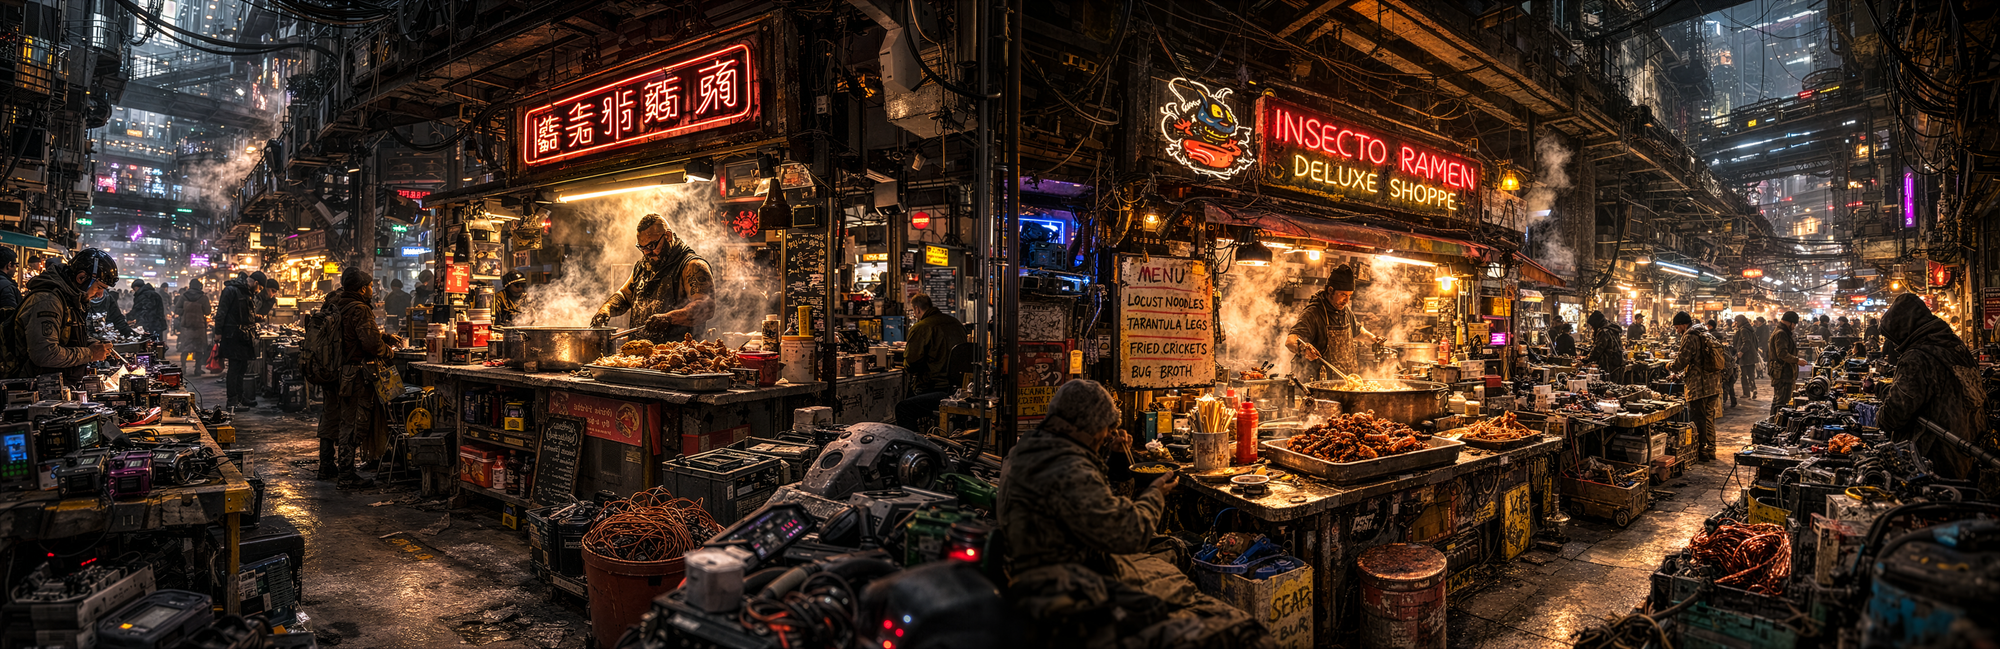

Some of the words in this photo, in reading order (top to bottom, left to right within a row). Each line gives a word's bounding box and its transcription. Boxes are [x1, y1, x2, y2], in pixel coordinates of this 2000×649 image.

[1275, 108, 1387, 164] INSECTO
[1401, 145, 1475, 190] RAMEN
[1294, 154, 1378, 193] DELUXE
[1389, 178, 1457, 211] SHOPPE
[1138, 265, 1185, 284] MENU
[1127, 294, 1163, 308] LOCUST
[1165, 296, 1204, 310] NOODLES
[1127, 317, 1182, 330] TARANTULA
[1185, 318, 1208, 331] LEGS
[1131, 365, 1152, 379] BUG
[1160, 365, 1193, 379] BROTH
